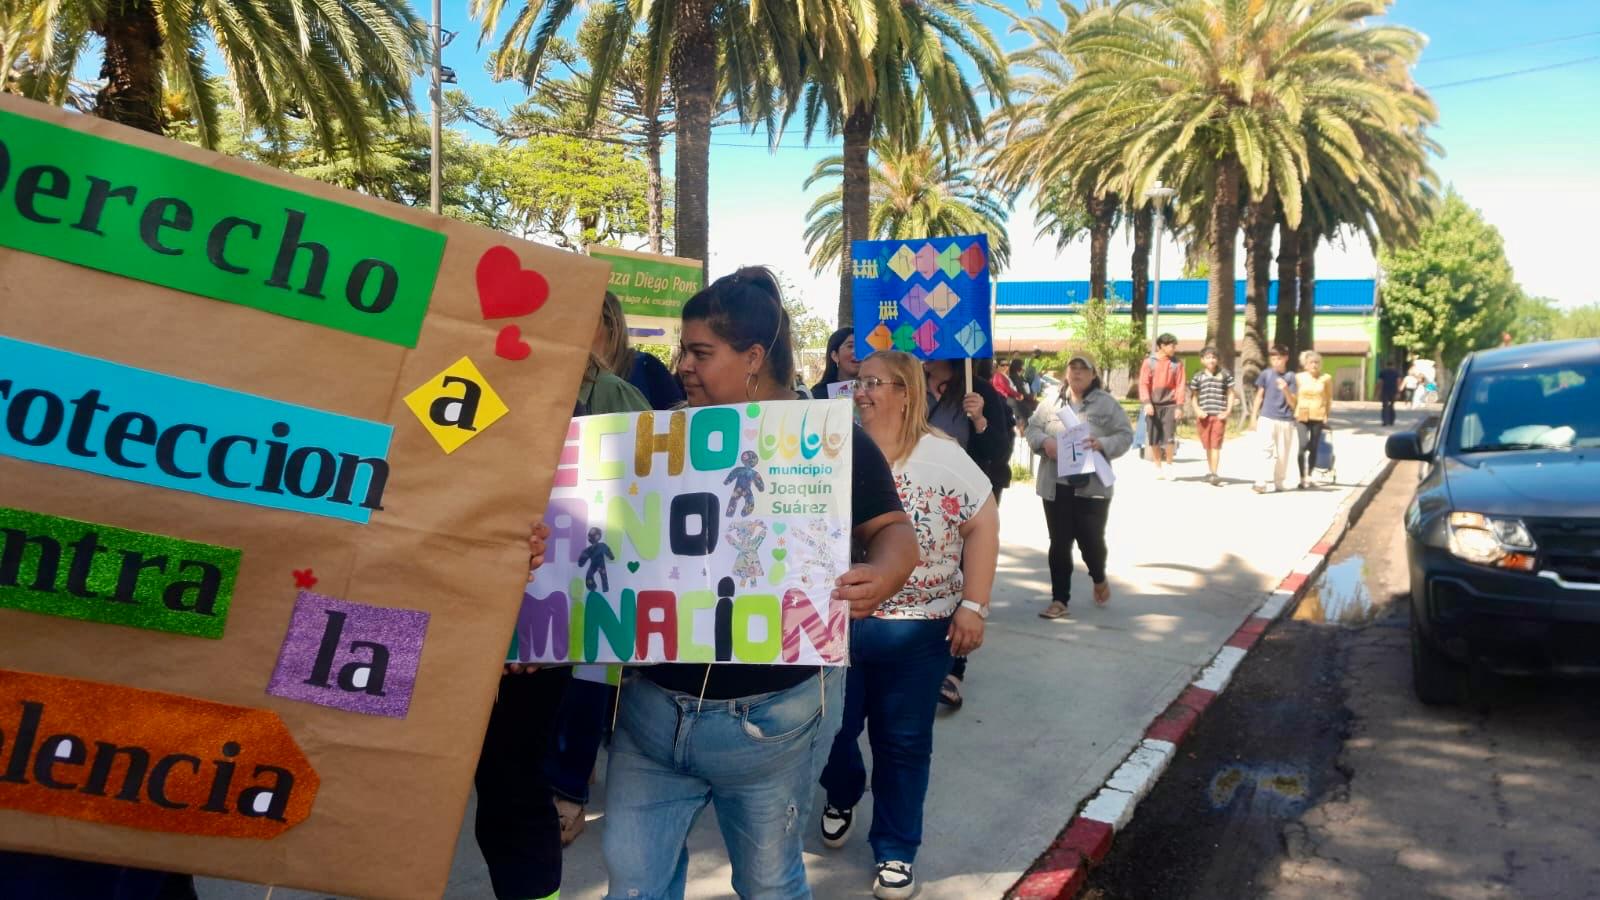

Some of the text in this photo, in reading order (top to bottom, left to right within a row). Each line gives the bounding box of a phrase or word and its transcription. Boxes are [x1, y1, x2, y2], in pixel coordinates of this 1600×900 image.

[0, 139, 400, 313] erecho
[634, 271, 668, 293] Diego
[672, 276, 698, 293] Pons
[429, 375, 482, 432] a
[0, 379, 390, 511] oteccion
[768, 464, 833, 477] municipio
[768, 480, 832, 497] Joaquín
[771, 499, 828, 514] Suárez
[303, 609, 391, 698] la
[0, 700, 296, 824] lencia
